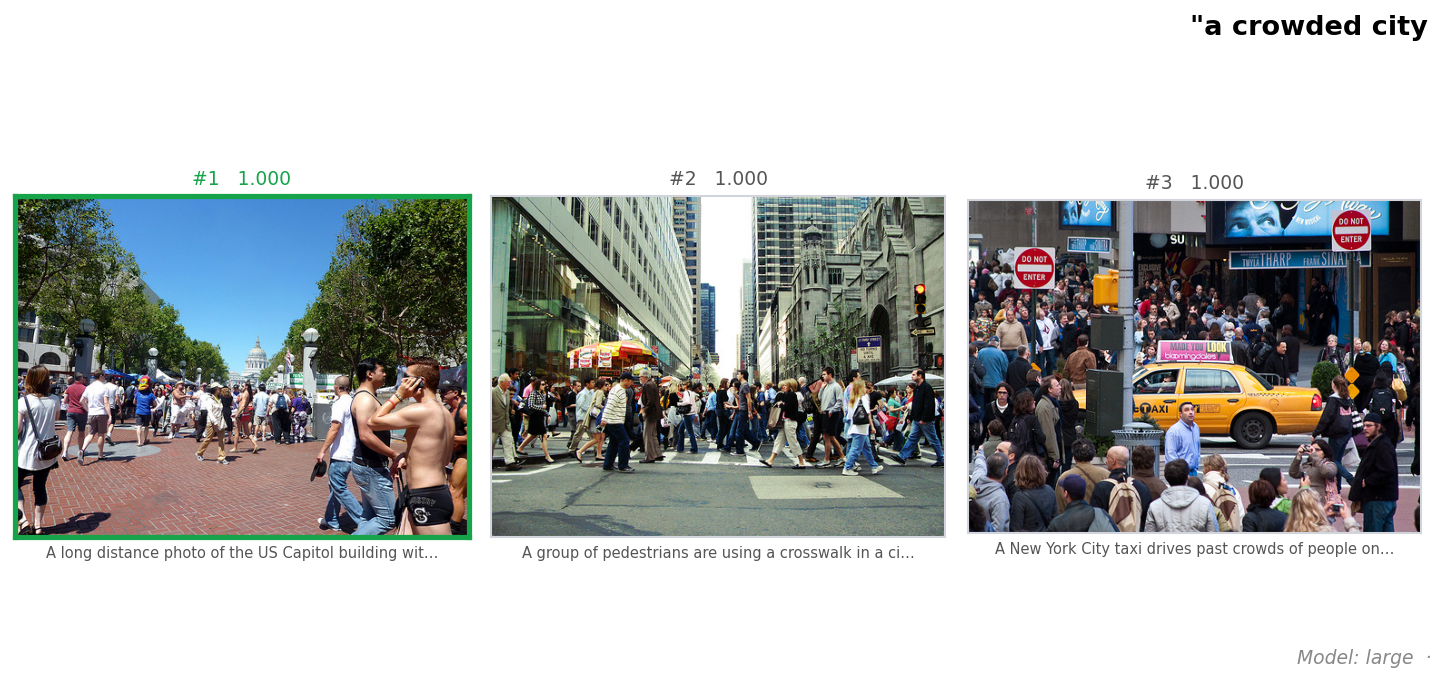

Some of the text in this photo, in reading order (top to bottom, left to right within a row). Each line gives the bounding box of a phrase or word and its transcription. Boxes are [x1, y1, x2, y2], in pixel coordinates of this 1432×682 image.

[1350, 217, 1363, 225] NOT
[1021, 255, 1047, 263] DO NOT
[1260, 252, 1292, 267] THARP
[1303, 257, 1320, 266] FRANK
[1023, 273, 1046, 281] ENTER
[1170, 342, 1227, 353] MADE YOU LOOK
